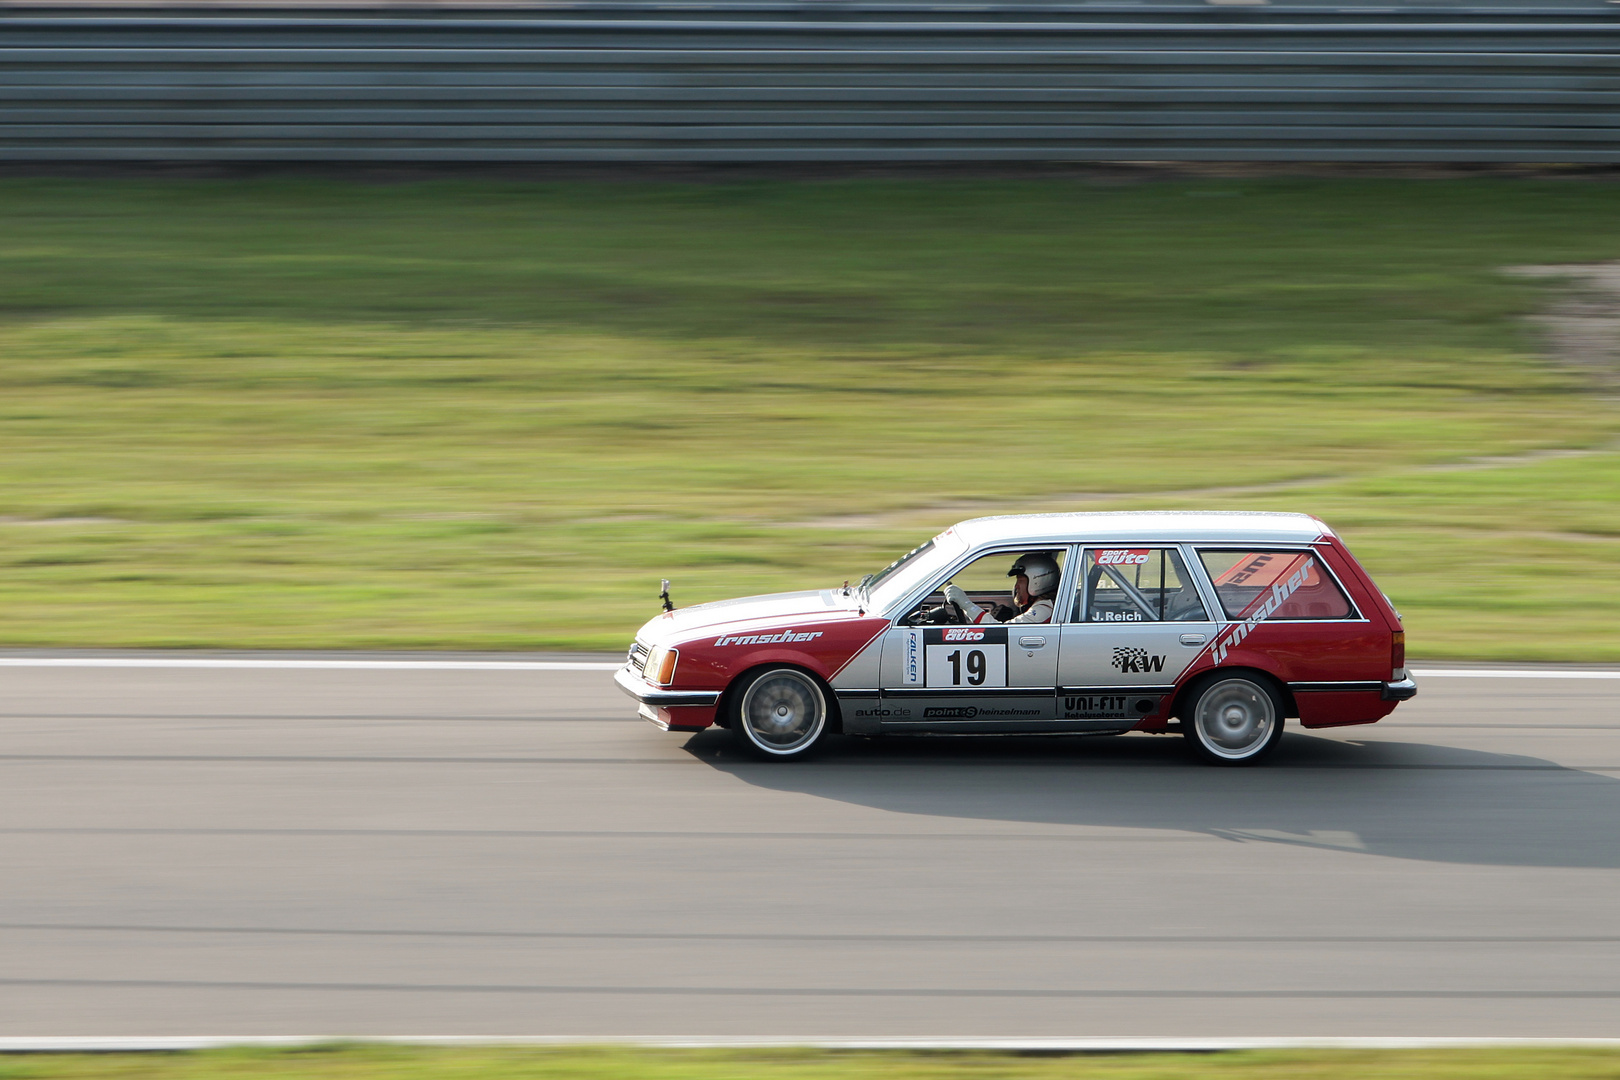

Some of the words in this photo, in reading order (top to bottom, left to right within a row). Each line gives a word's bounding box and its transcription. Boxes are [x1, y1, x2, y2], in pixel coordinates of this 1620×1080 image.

[1098, 553, 1150, 565] auto
[1210, 557, 1314, 667] irmscher
[714, 630, 823, 647] irmscher
[945, 632, 985, 641] auto
[947, 649, 987, 686] 19
[1121, 655, 1167, 674] KW
[1065, 697, 1127, 710] UNI-FIT
[855, 707, 911, 717] auto.de
[979, 708, 1041, 716] heinzelmann
